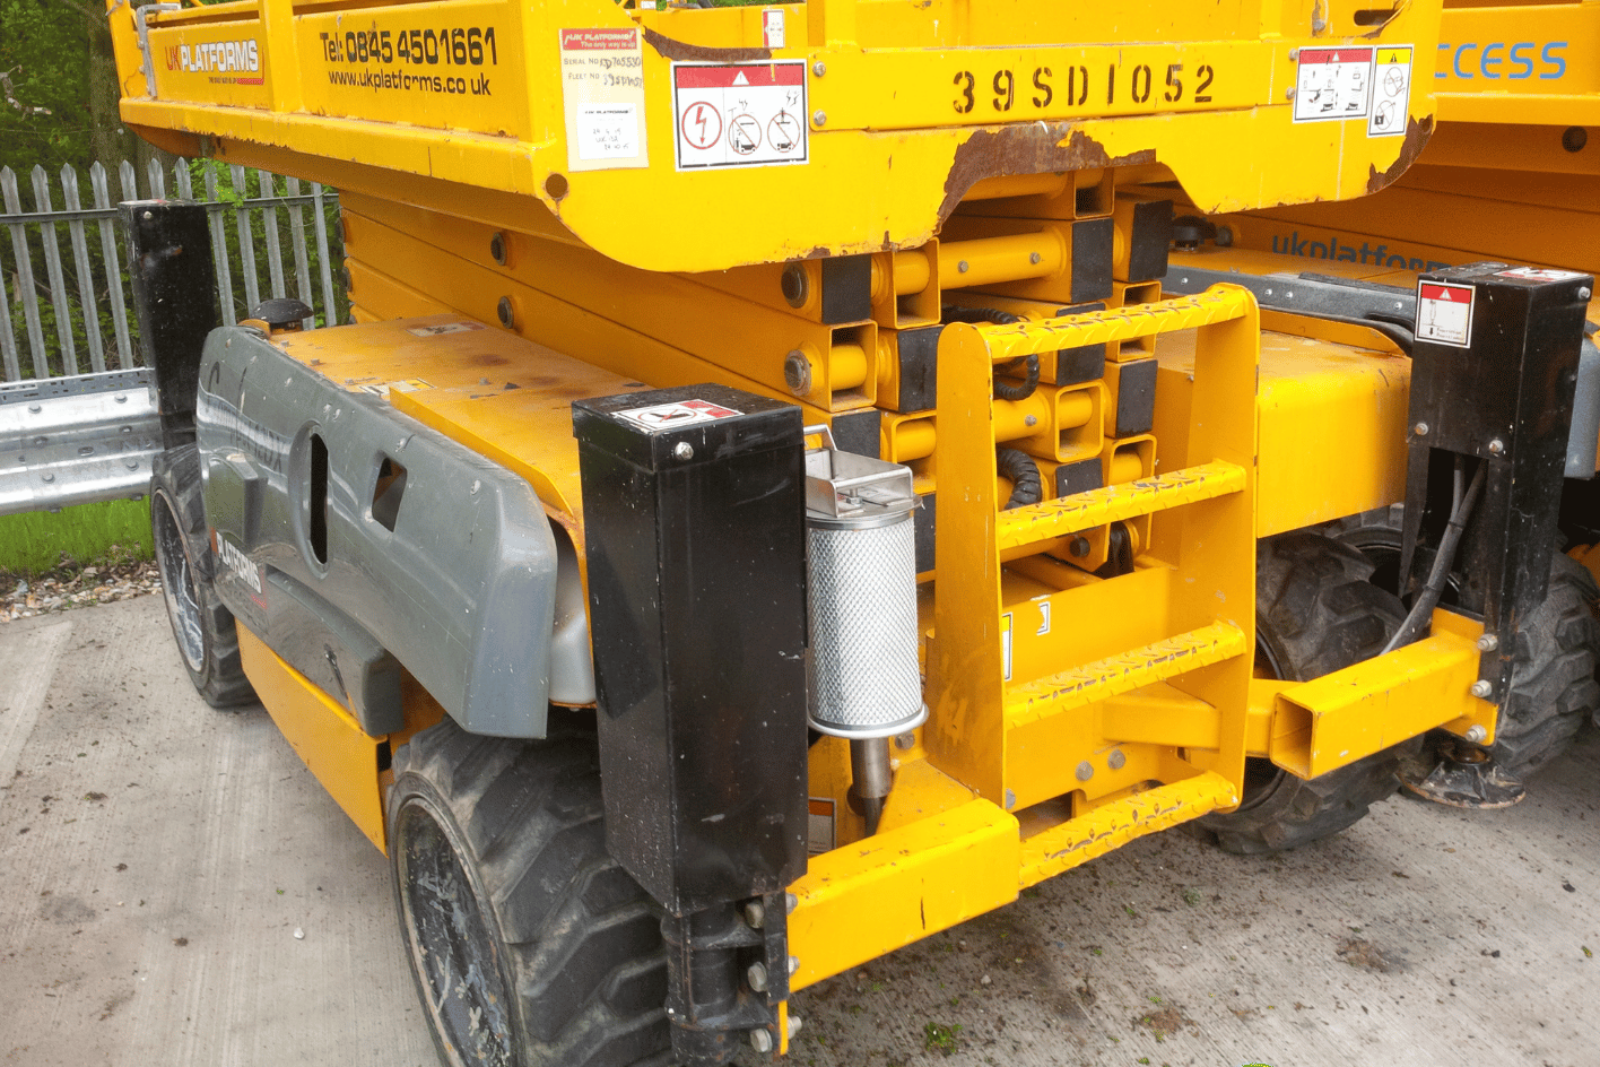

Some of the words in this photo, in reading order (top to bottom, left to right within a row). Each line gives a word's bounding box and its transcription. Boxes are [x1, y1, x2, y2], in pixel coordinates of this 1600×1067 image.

[319, 32, 344, 62] Tel:
[345, 30, 393, 63] 0845
[396, 26, 497, 66] 4501661
